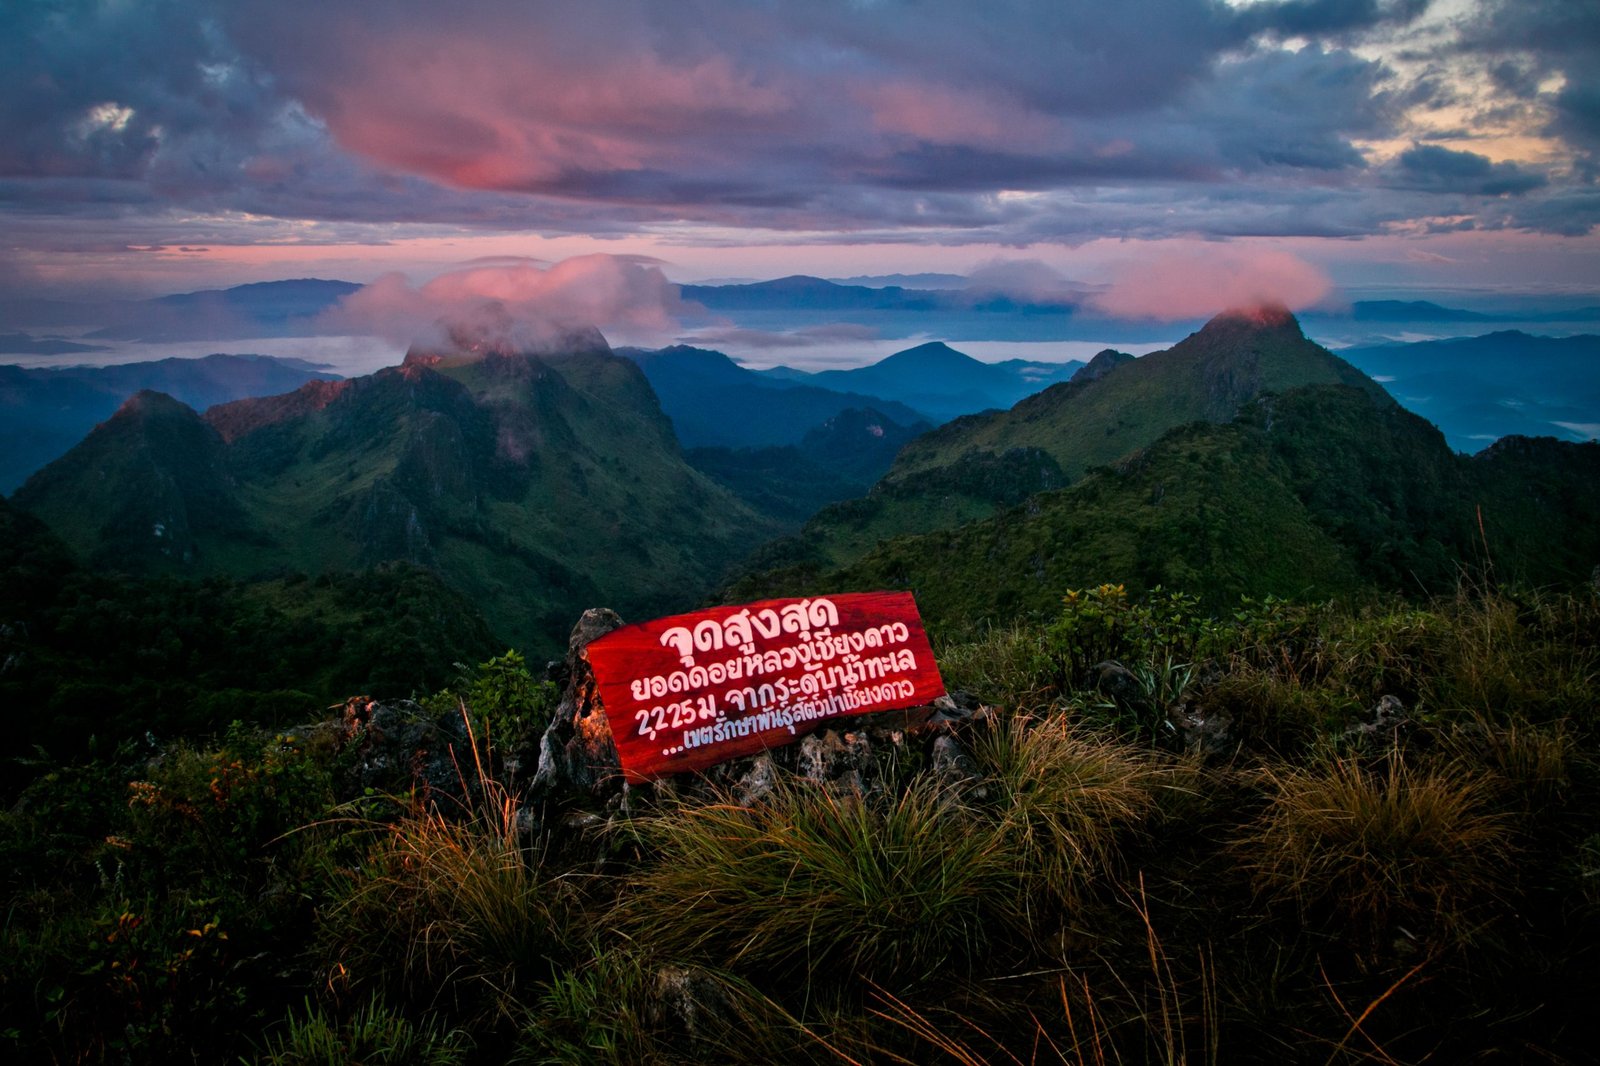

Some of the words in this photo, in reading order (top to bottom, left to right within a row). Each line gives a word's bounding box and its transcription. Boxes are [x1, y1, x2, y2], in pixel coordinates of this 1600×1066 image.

[631, 622, 909, 701] ยอดดอยหลวงเชียงดาว
[660, 598, 839, 667] จุดสูงสุด
